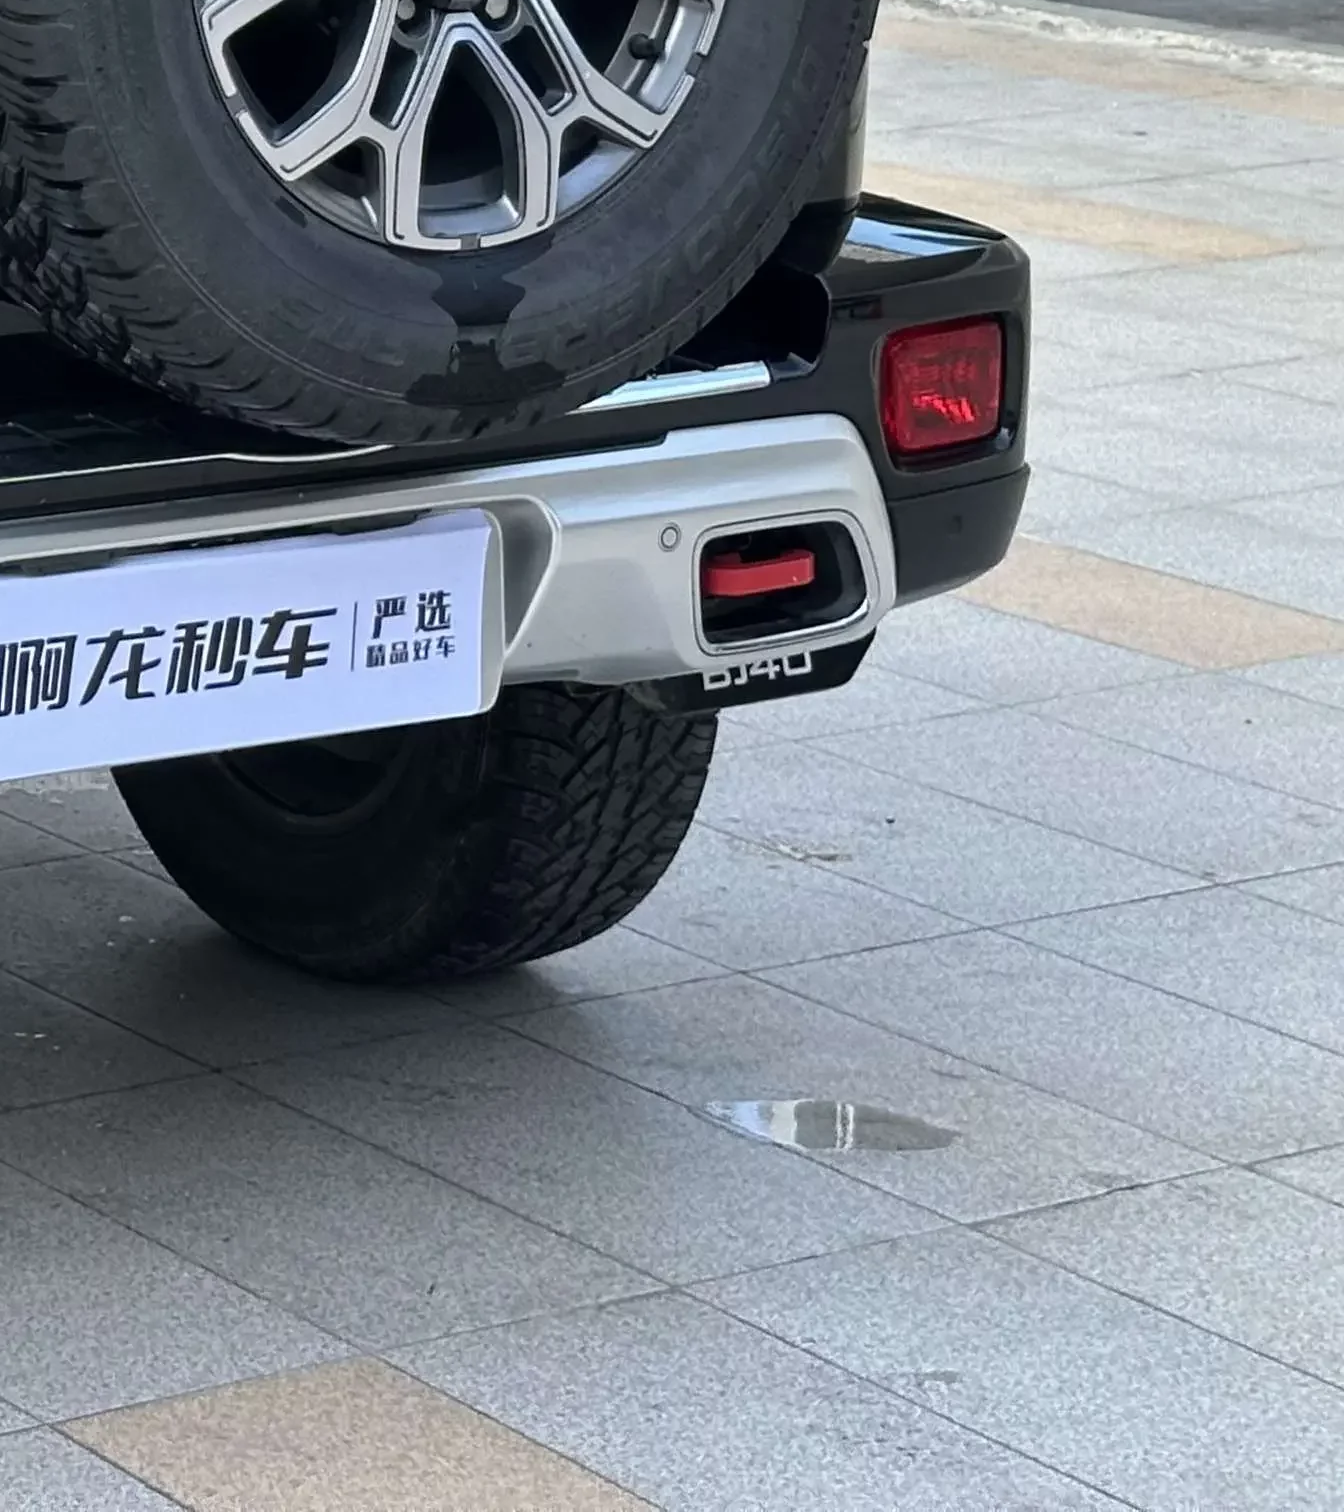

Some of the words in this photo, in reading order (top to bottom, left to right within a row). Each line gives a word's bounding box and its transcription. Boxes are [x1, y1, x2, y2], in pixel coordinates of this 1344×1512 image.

[372, 589, 453, 641] 严选
[365, 635, 457, 669] 精品好车
